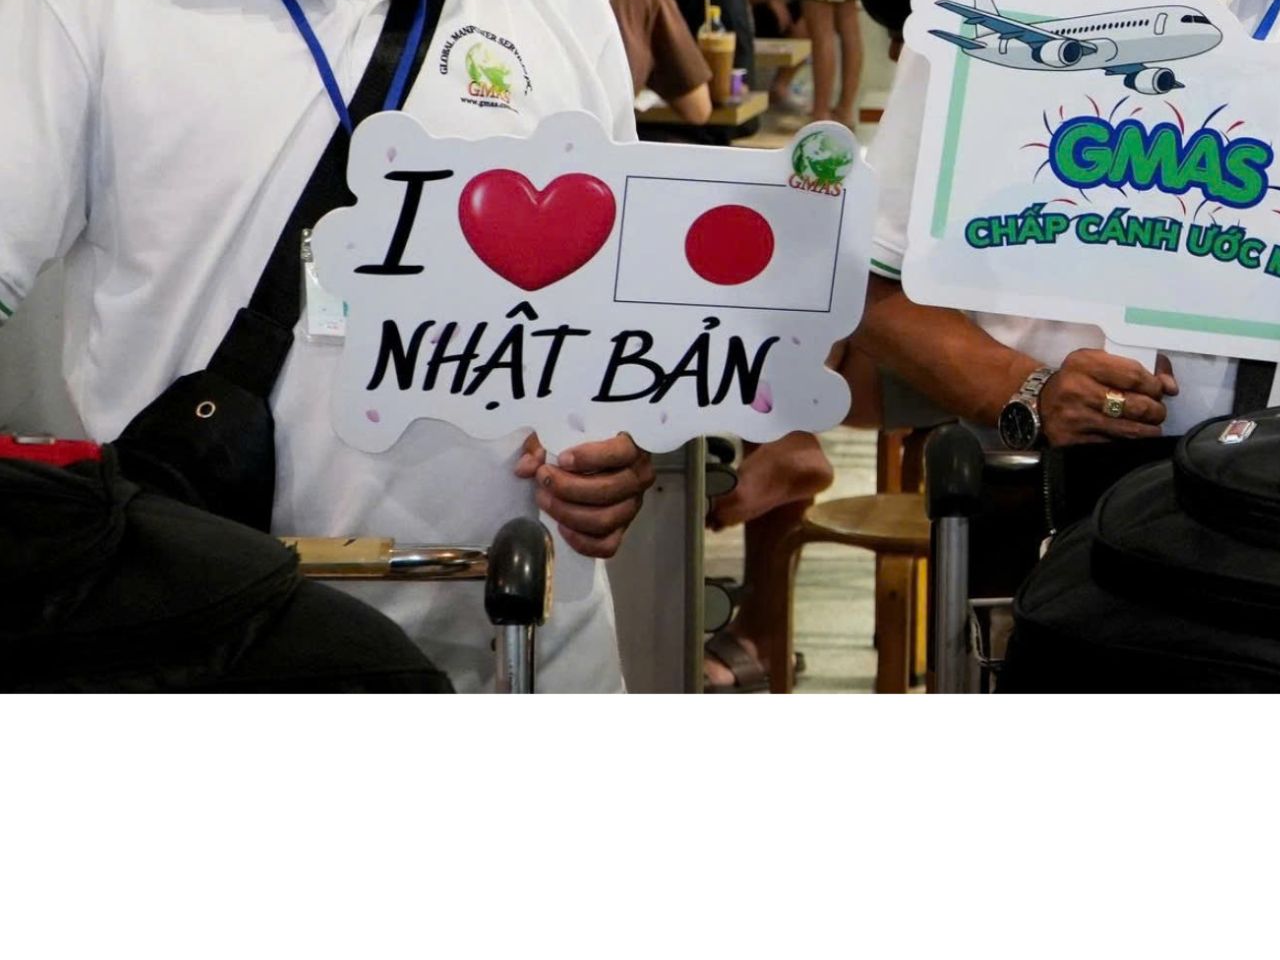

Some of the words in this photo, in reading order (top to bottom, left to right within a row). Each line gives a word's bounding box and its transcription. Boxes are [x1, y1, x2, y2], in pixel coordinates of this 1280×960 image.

[788, 173, 842, 197] GMAS
[1048, 116, 1274, 209] GMAS
[353, 169, 454, 275] I
[965, 202, 1070, 248] CHẤP
[1075, 208, 1183, 252] CÁNH
[1186, 221, 1266, 269] ƯỚC
[366, 301, 591, 410] NHẬT
[591, 316, 780, 408] BẢN
